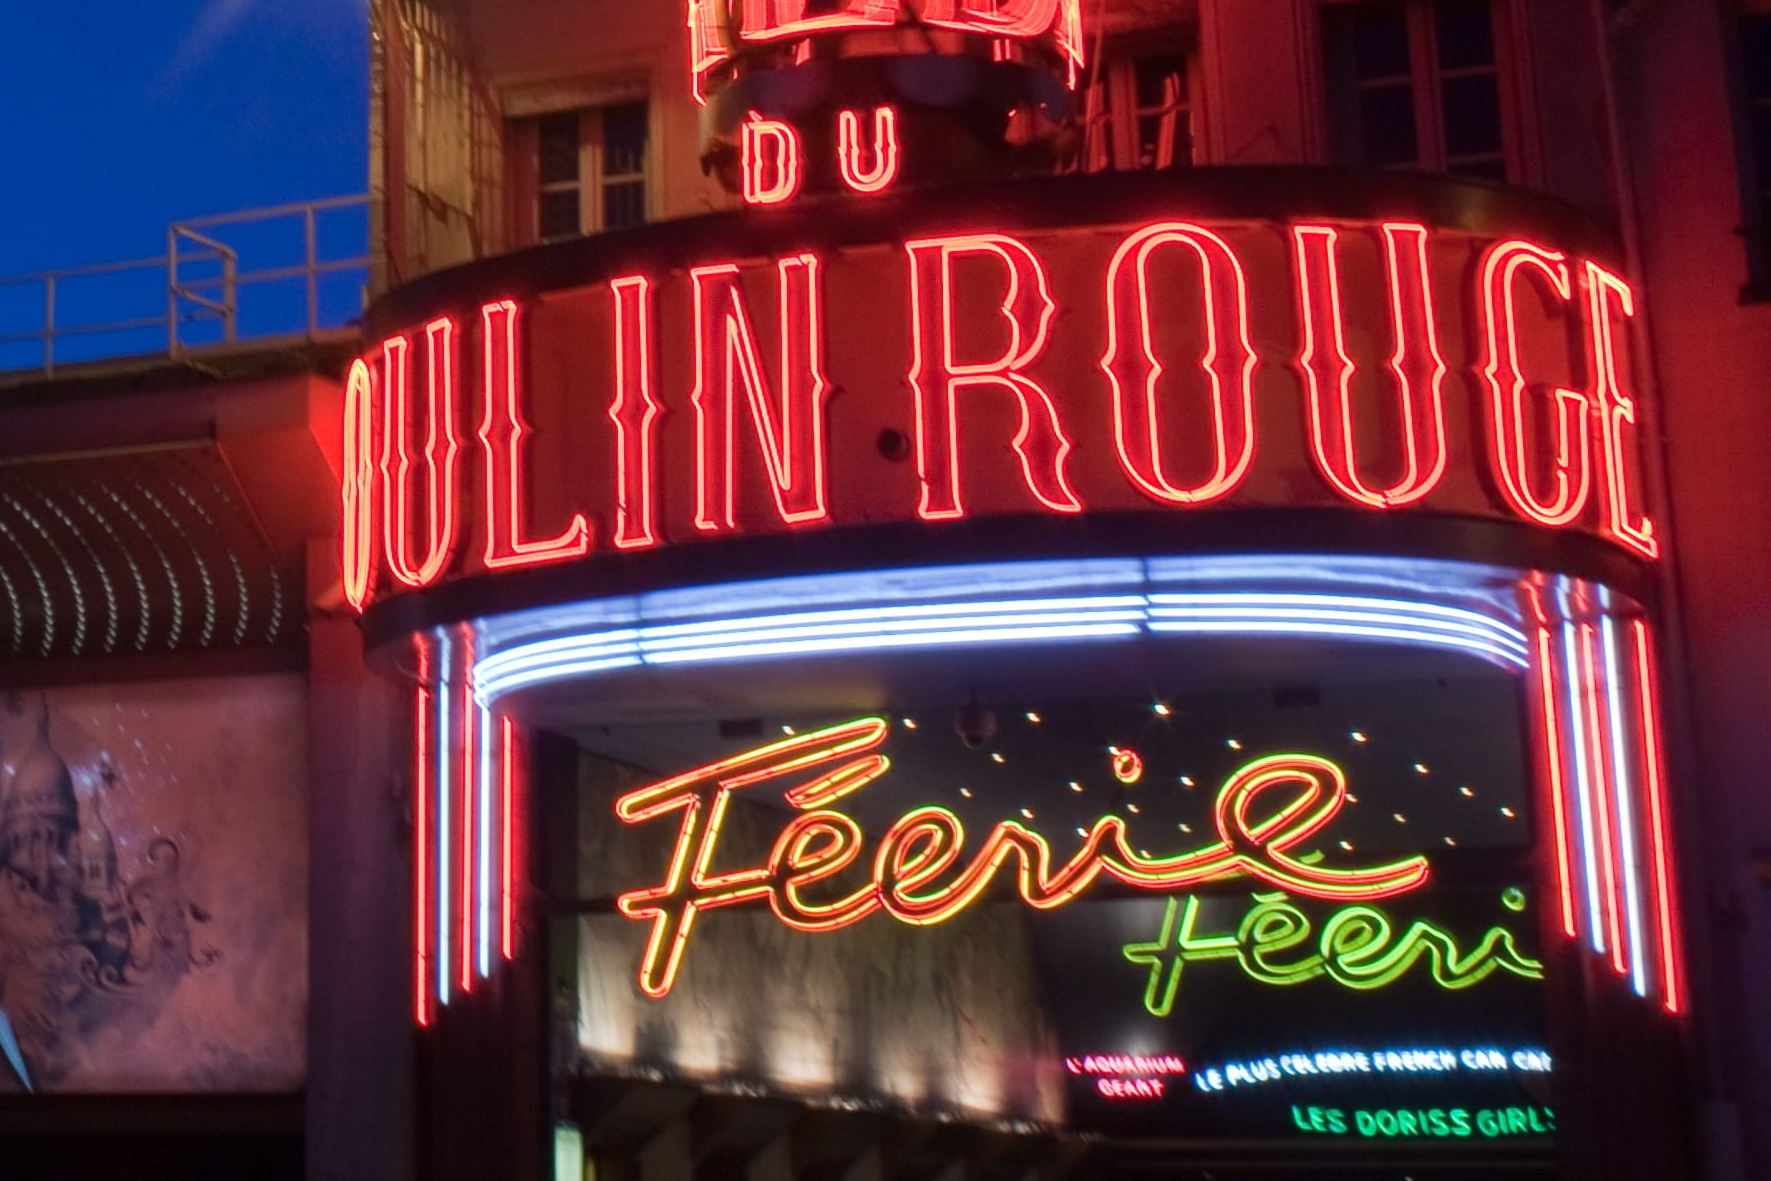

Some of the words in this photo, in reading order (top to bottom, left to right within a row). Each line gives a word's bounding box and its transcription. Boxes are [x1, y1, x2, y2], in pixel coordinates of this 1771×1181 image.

[740, 107, 898, 204] DU
[340, 253, 826, 613] OULIN
[905, 222, 1659, 560] ROUGE
[616, 716, 1428, 998] Féerie
[1122, 881, 1545, 1017] Féeri
[1194, 1067, 1224, 1093] LE
[1226, 1057, 1283, 1087] PLUS
[1372, 1048, 1458, 1073] FRENCH
[1459, 1047, 1508, 1071] CAN
[1291, 1103, 1348, 1133] LES
[1354, 1107, 1473, 1137] DORISS
